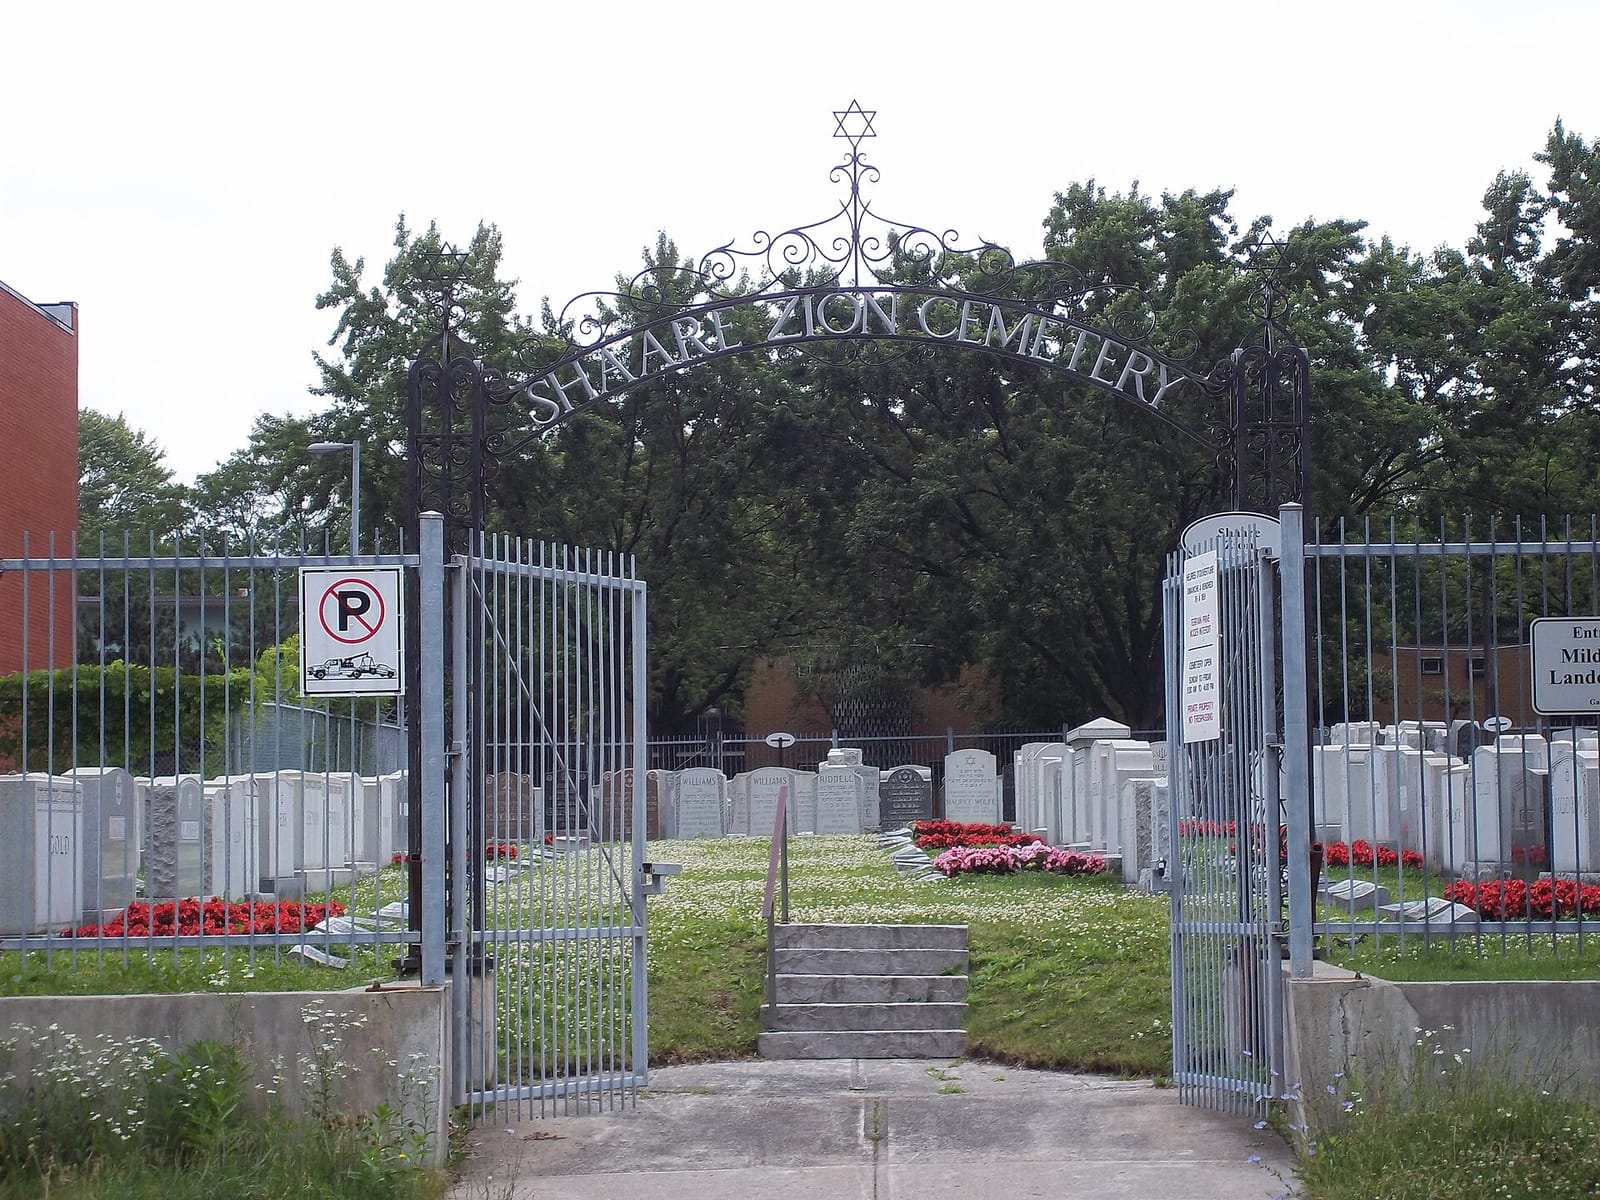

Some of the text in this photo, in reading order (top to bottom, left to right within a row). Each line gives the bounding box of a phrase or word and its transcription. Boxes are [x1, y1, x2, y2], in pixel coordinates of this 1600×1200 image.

[526, 292, 1190, 425] SHAARE ZION CEMETERY
[338, 591, 371, 632] P
[1573, 626, 1600, 639] Ent
[1561, 648, 1600, 664] Mild
[682, 777, 717, 786] WILLIAMS
[753, 777, 788, 786] WILLIAMS
[819, 774, 854, 784] RIDDELL
